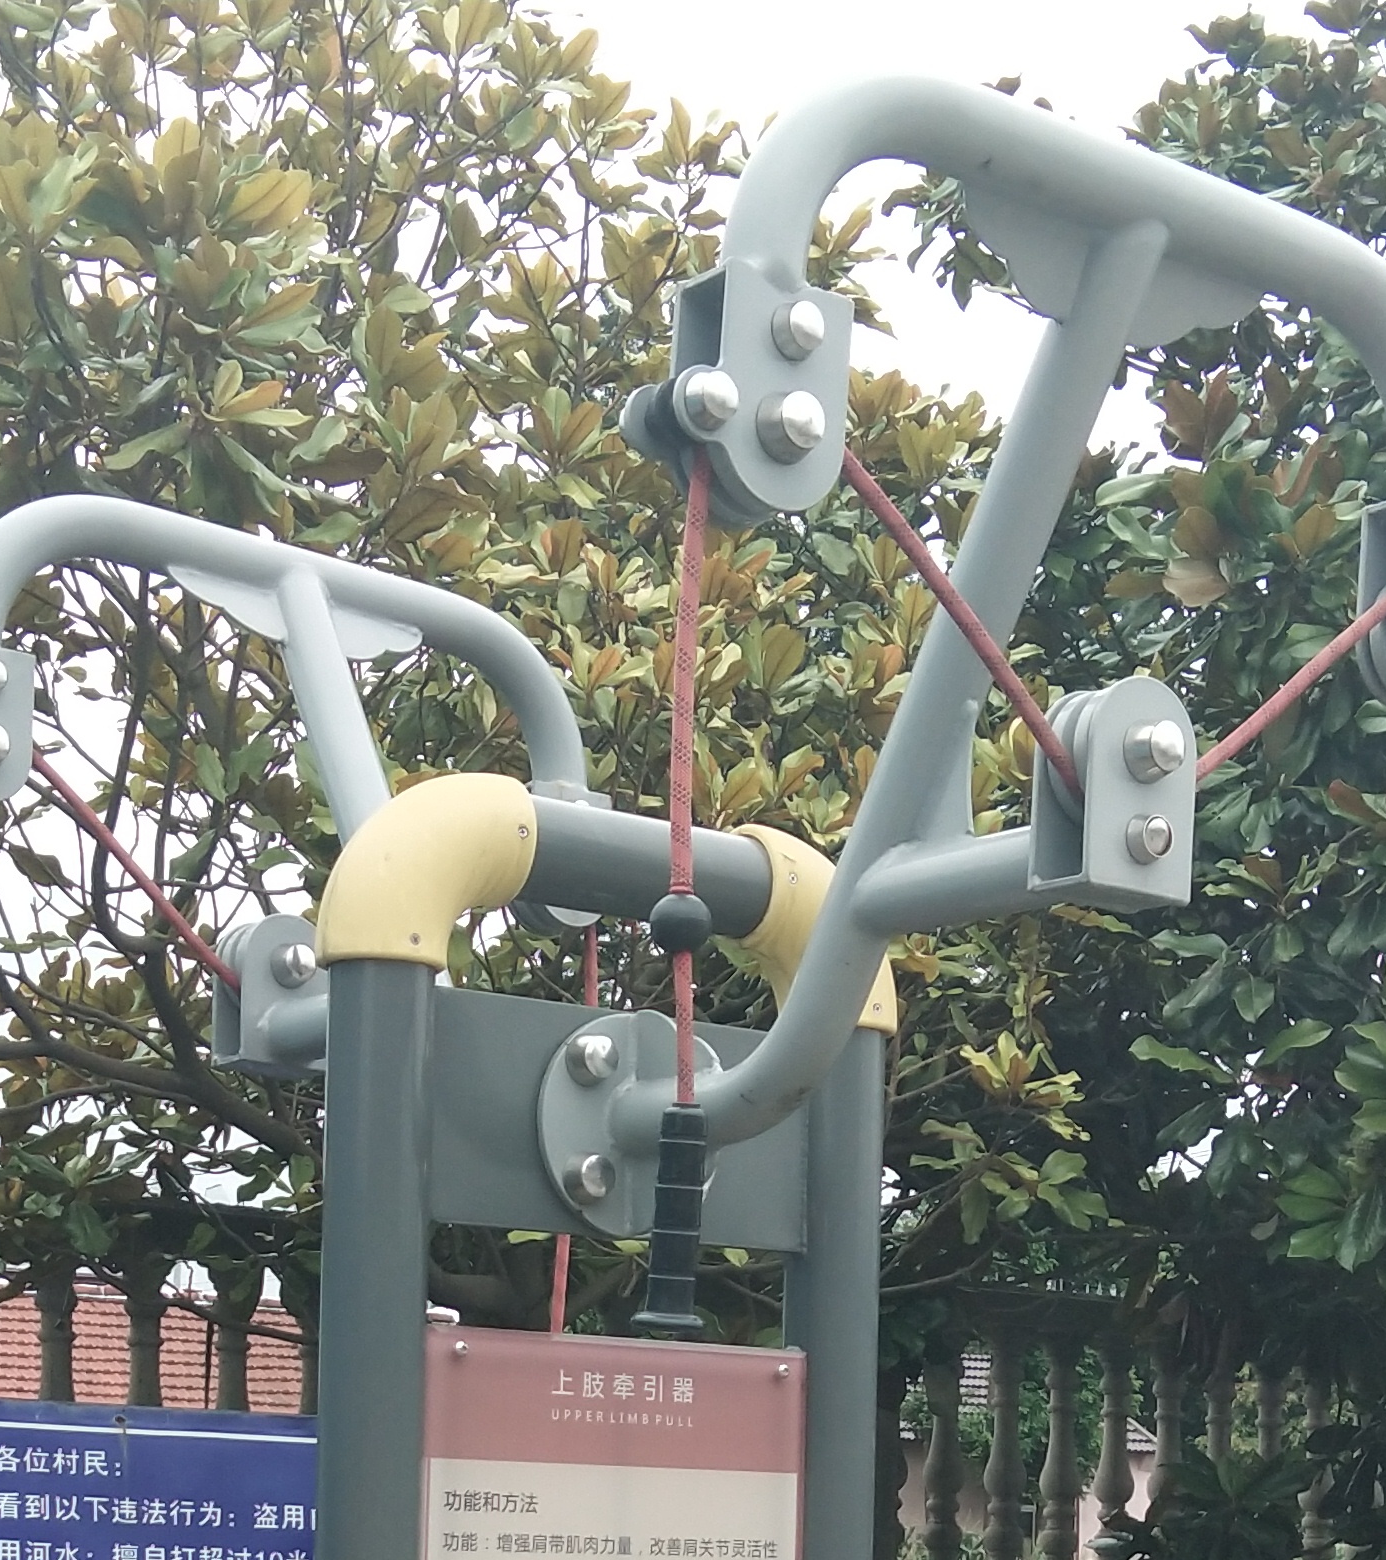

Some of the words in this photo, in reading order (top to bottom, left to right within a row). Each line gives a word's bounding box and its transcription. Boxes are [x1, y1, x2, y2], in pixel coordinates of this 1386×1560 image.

[551, 1369, 695, 1404] 上肢牵引器
[551, 1408, 604, 1423] UPPER
[609, 1411, 650, 1426] LIMB
[654, 1414, 695, 1428] PULL
[443, 1490, 539, 1514] 功能和方法
